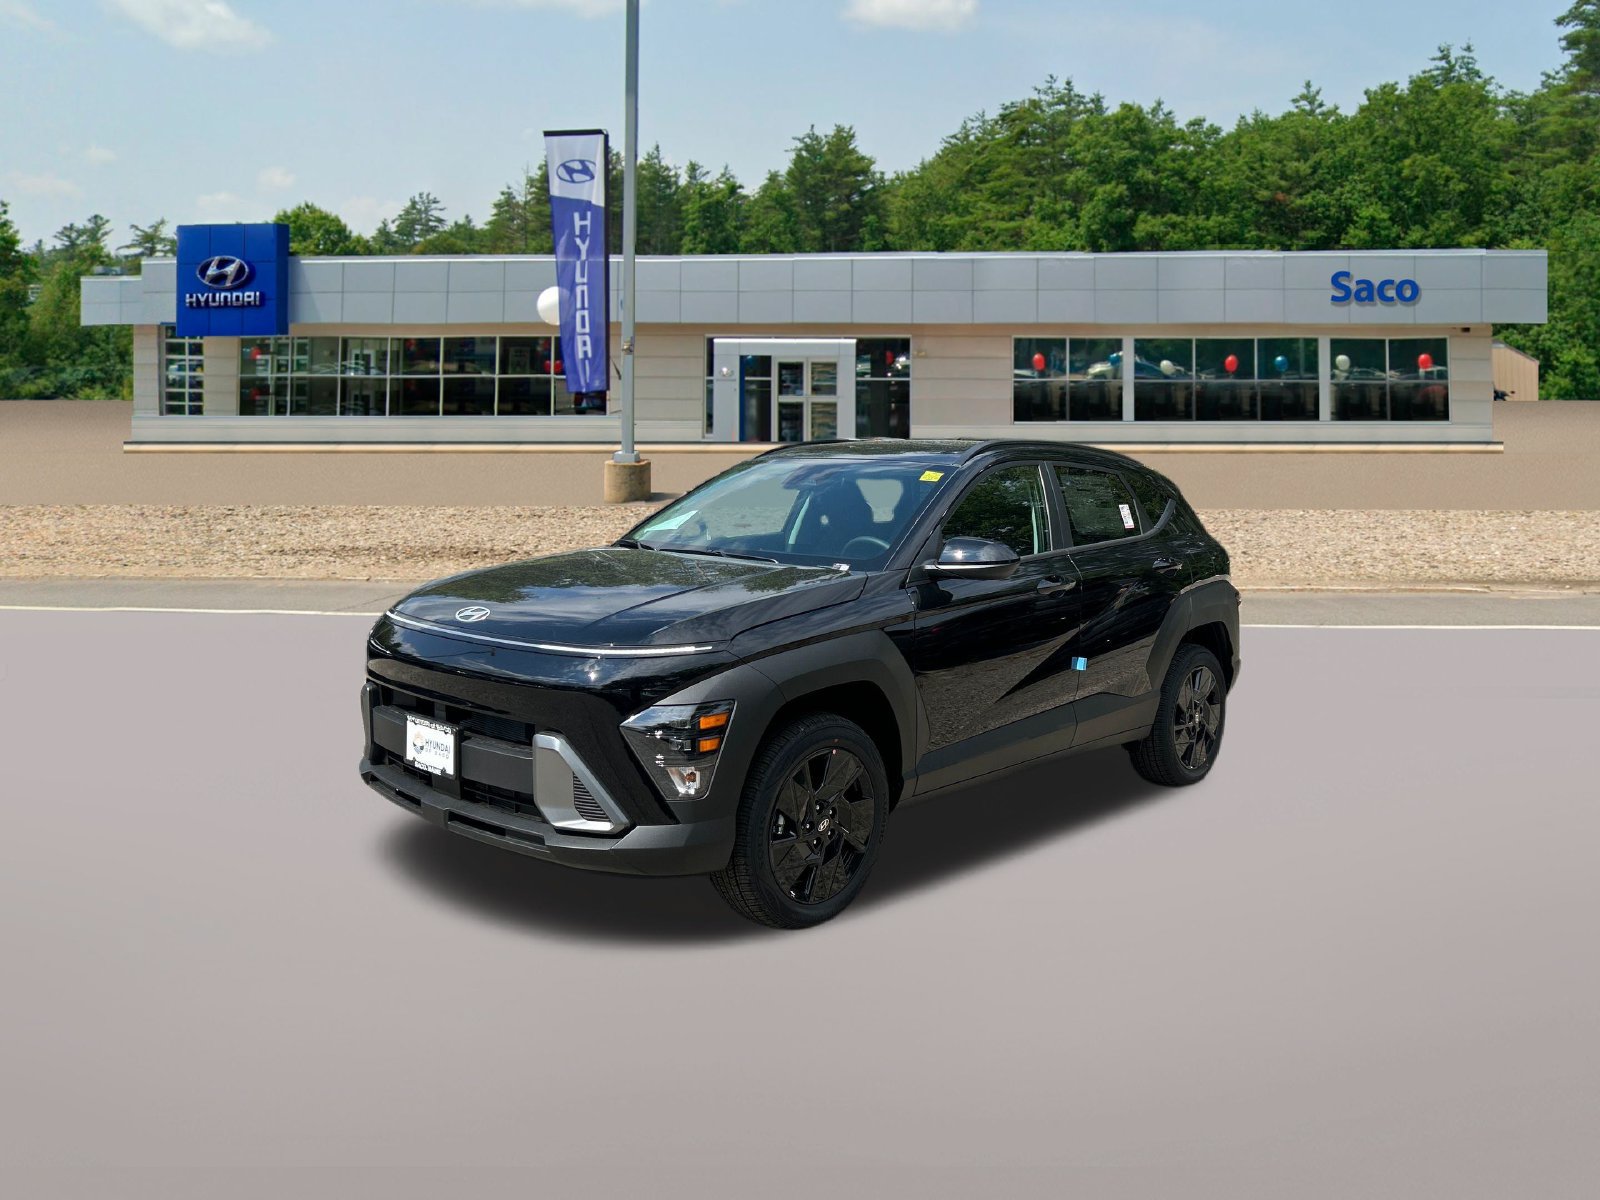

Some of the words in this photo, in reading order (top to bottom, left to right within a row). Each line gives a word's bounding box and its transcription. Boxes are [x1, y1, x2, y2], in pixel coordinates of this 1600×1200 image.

[573, 211, 593, 384] HYUNDAI
[1330, 270, 1420, 303] Saco
[185, 291, 260, 307] HYUNDAI
[425, 739, 451, 754] HYUNDAI
